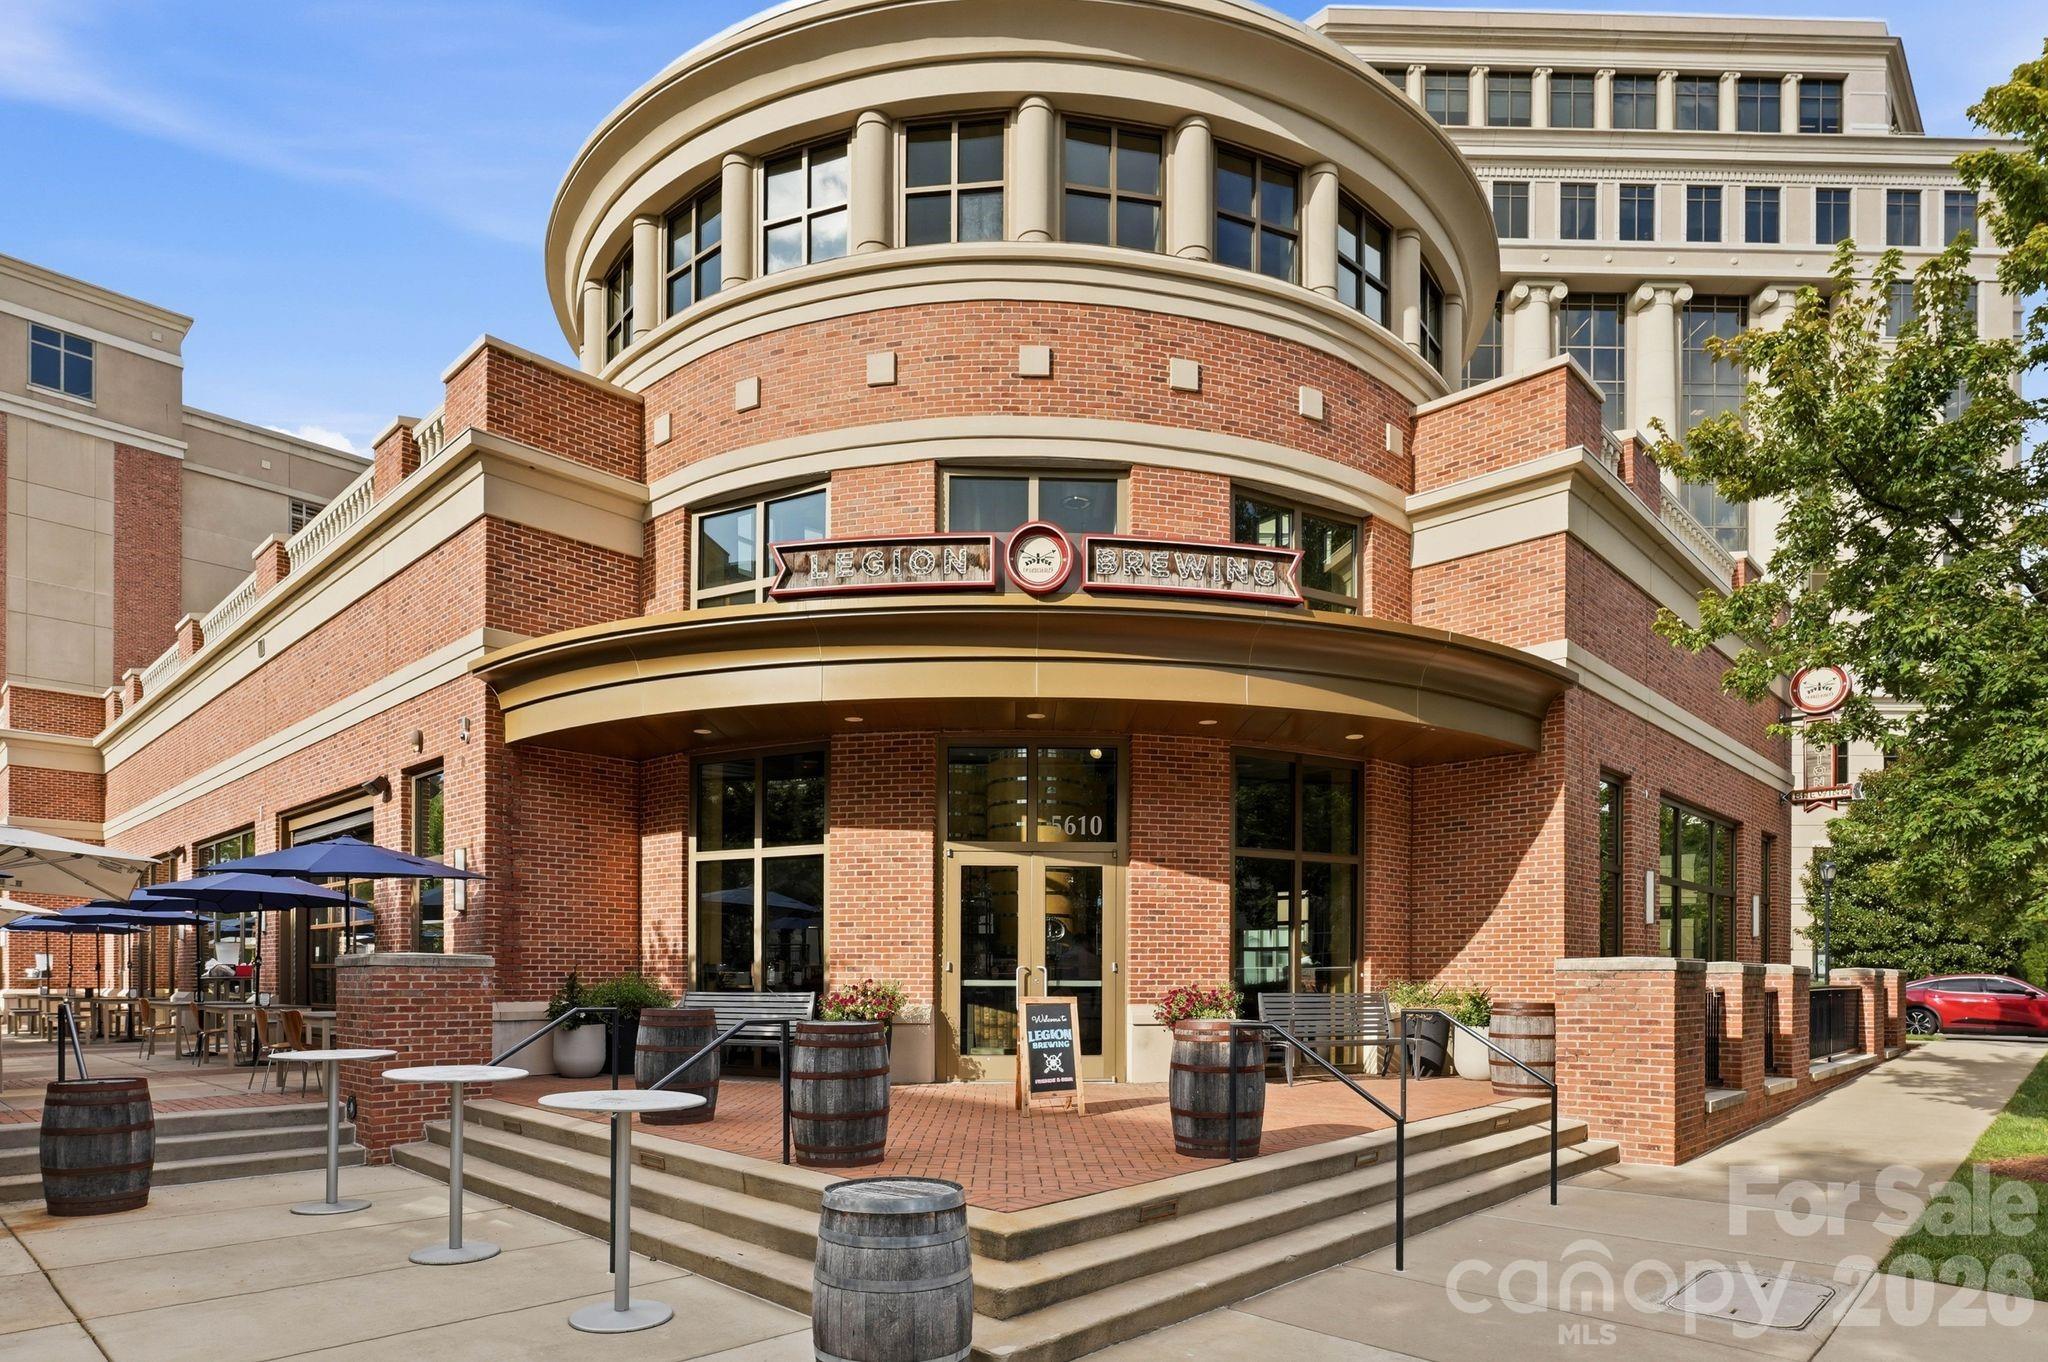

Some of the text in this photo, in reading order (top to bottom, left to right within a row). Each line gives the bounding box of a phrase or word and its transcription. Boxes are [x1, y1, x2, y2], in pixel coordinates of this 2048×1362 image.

[811, 548, 1276, 587] LEGION BREWING
[1051, 815, 1103, 836] 5610
[1028, 1028, 1072, 1042] LEGION
[1032, 1040, 1070, 1049] BREWING
